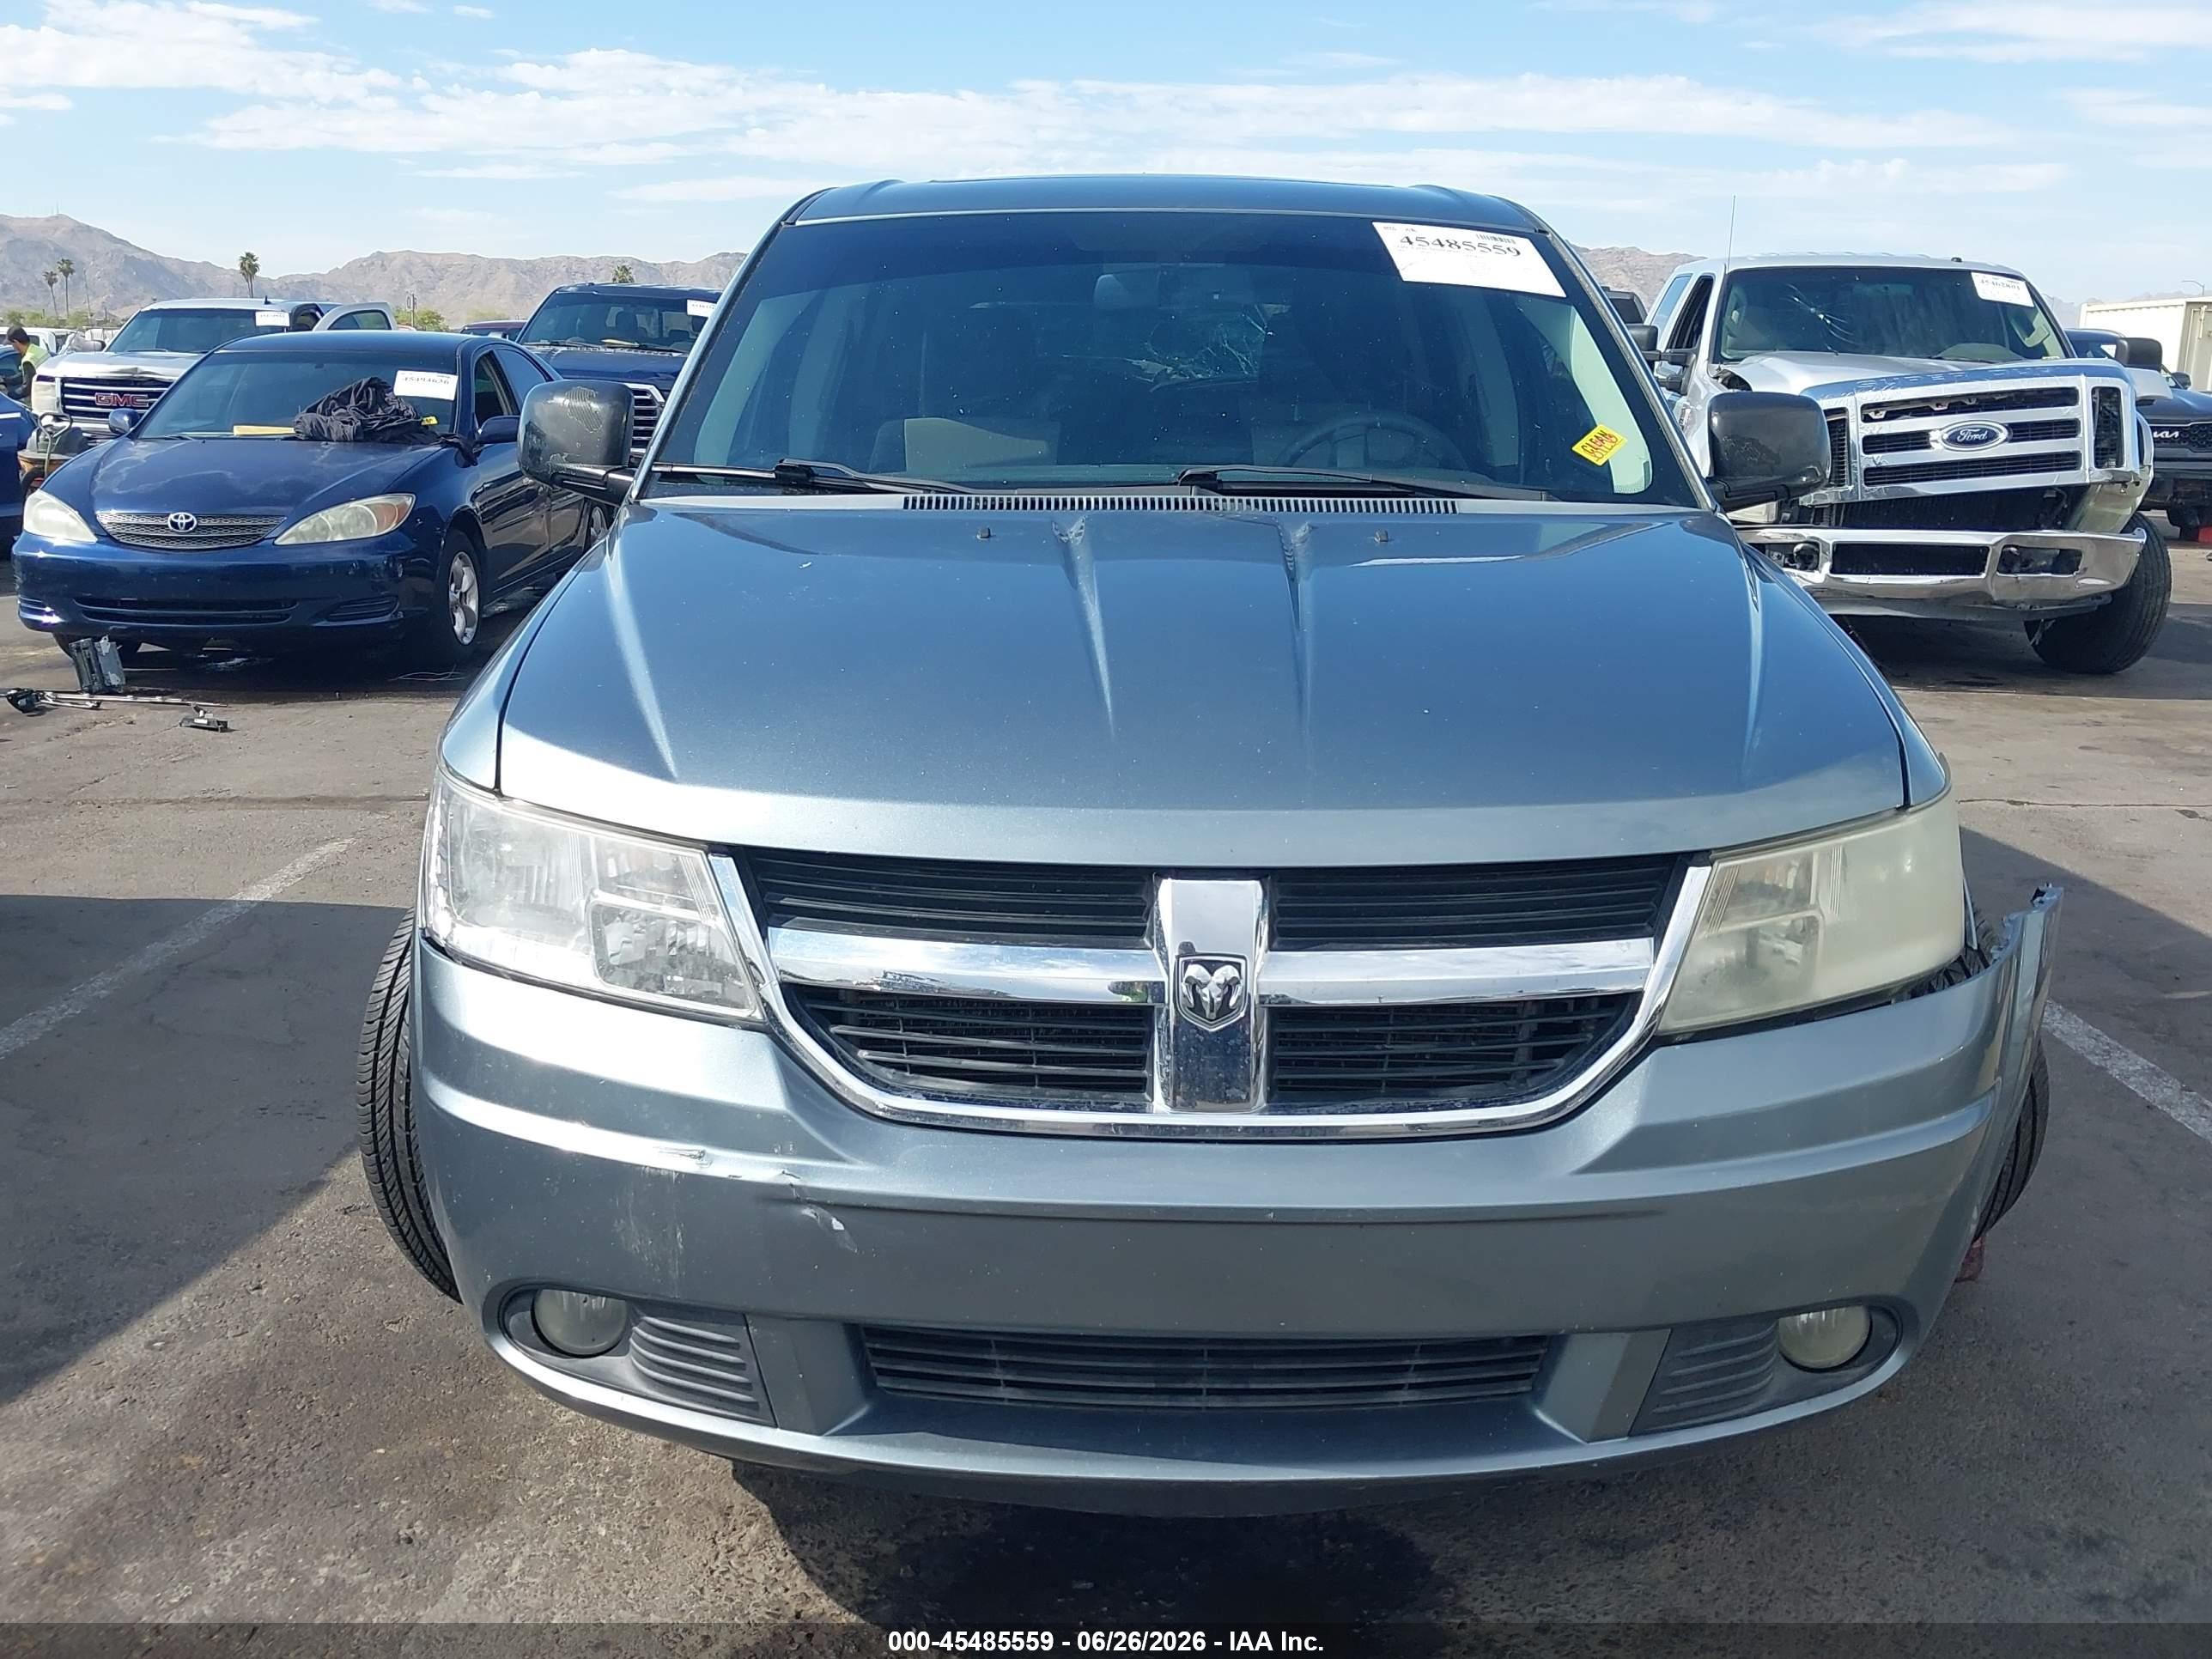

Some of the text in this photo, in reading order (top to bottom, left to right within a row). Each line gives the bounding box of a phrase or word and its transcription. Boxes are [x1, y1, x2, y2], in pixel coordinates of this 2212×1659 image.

[1400, 235, 1522, 257] 45485559
[95, 392, 149, 408] GMC
[1581, 429, 1609, 454] CLEAN
[1957, 429, 1989, 442] Ford
[2153, 430, 2179, 439] KIA
